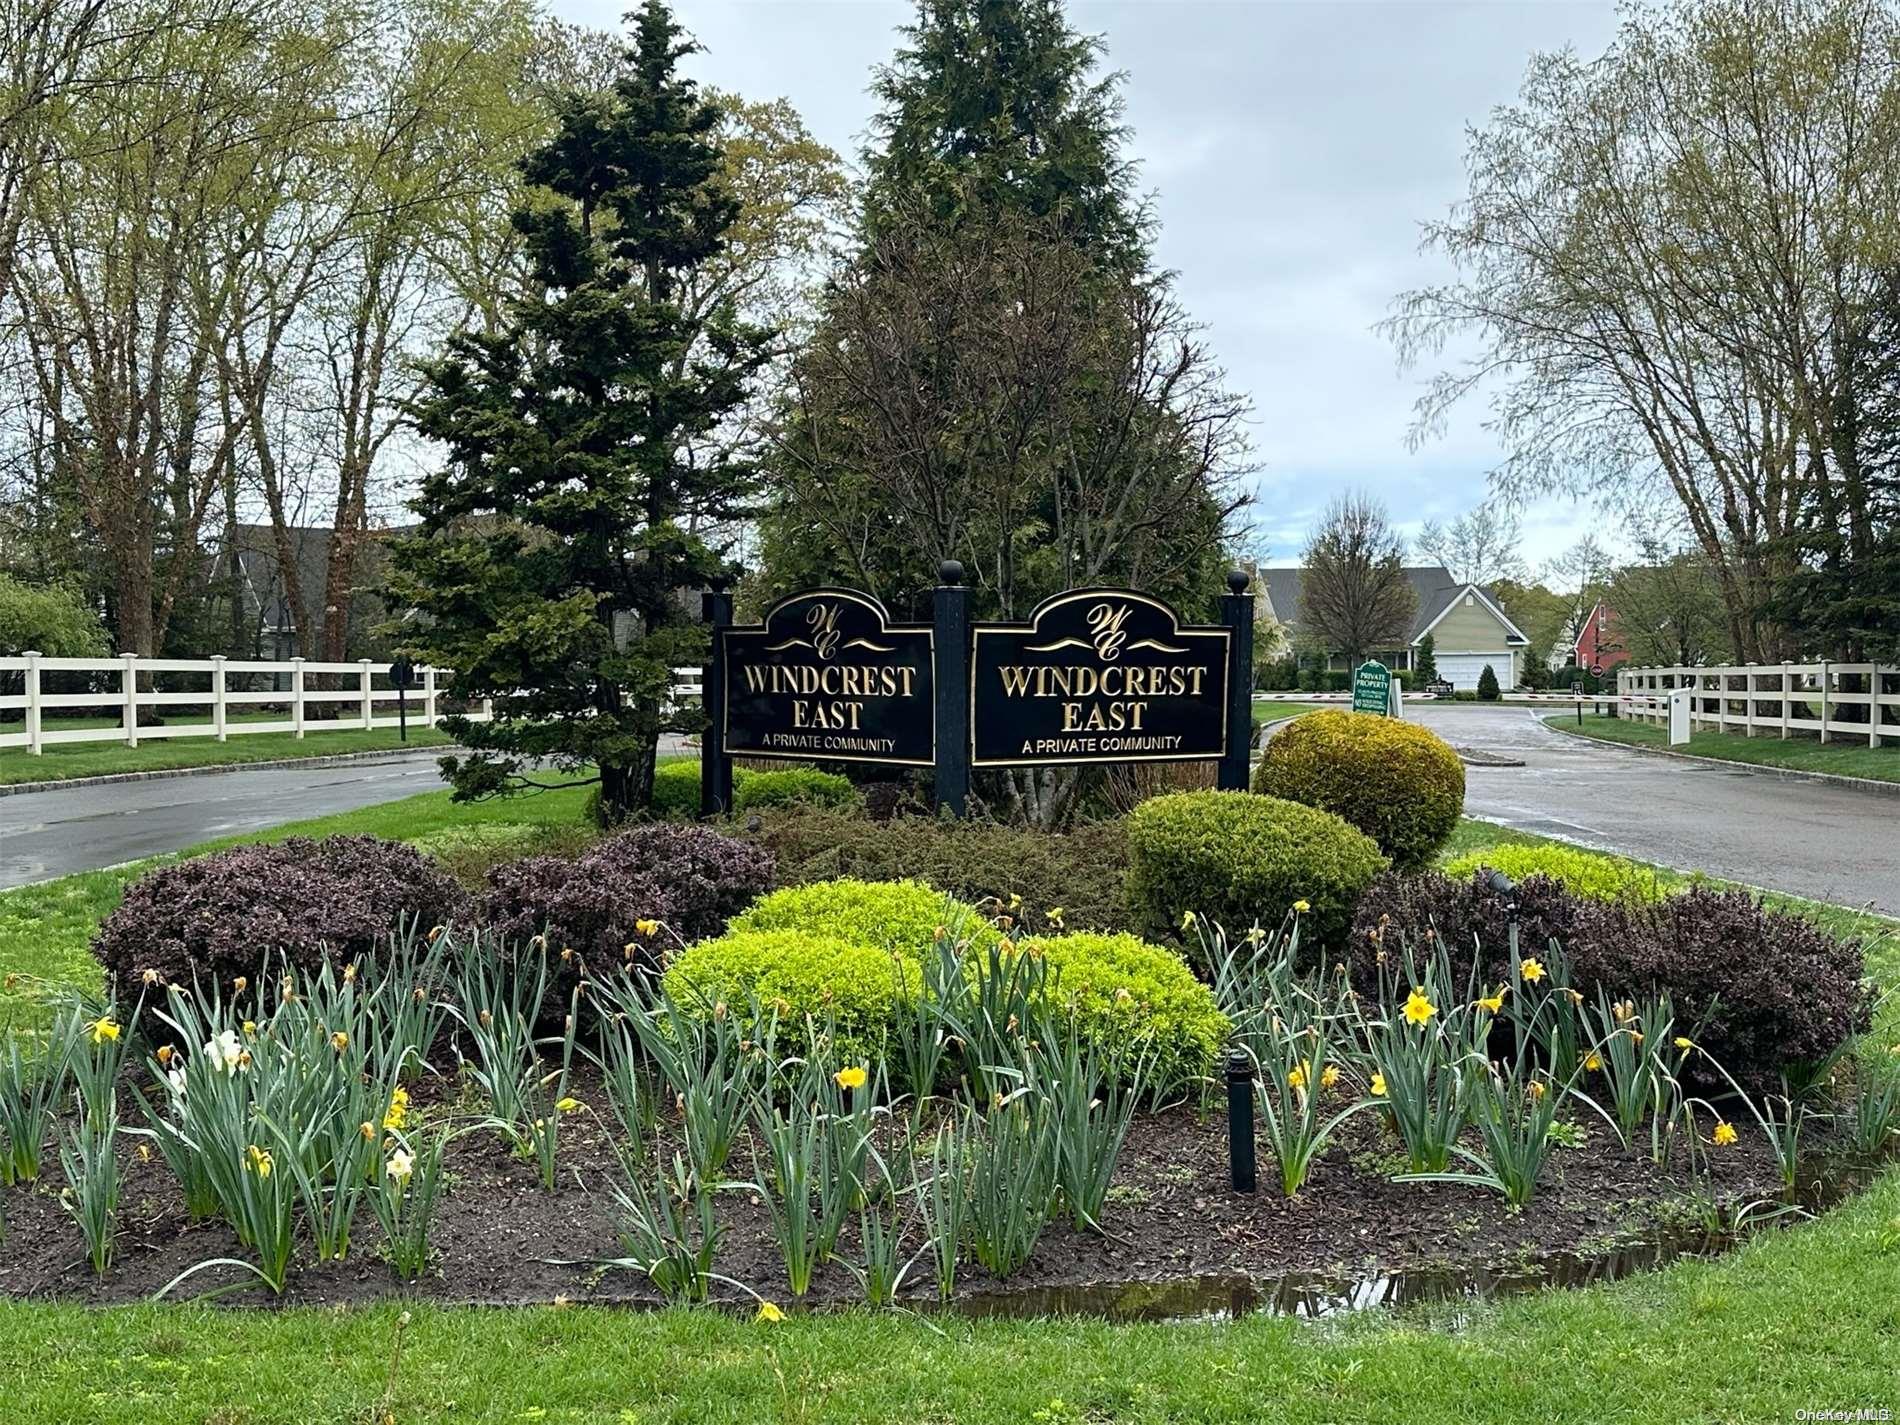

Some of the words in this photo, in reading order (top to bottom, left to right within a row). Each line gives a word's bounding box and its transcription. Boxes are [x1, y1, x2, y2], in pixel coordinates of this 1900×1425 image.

[743, 665, 916, 697] WINDCREST
[998, 666, 1207, 697] WINDCREST
[1356, 679, 1389, 689] PROPERTY
[1360, 672, 1386, 682] PRIVATE
[793, 700, 864, 730] EAST
[1061, 702, 1148, 732] EAST
[762, 734, 771, 745] A
[773, 735, 821, 748] PRIVATE
[824, 736, 896, 752] COMMUNITY
[1022, 740, 1033, 754] A
[1036, 738, 1097, 753] PRIVATE
[1099, 735, 1182, 751] COMMUNITY
